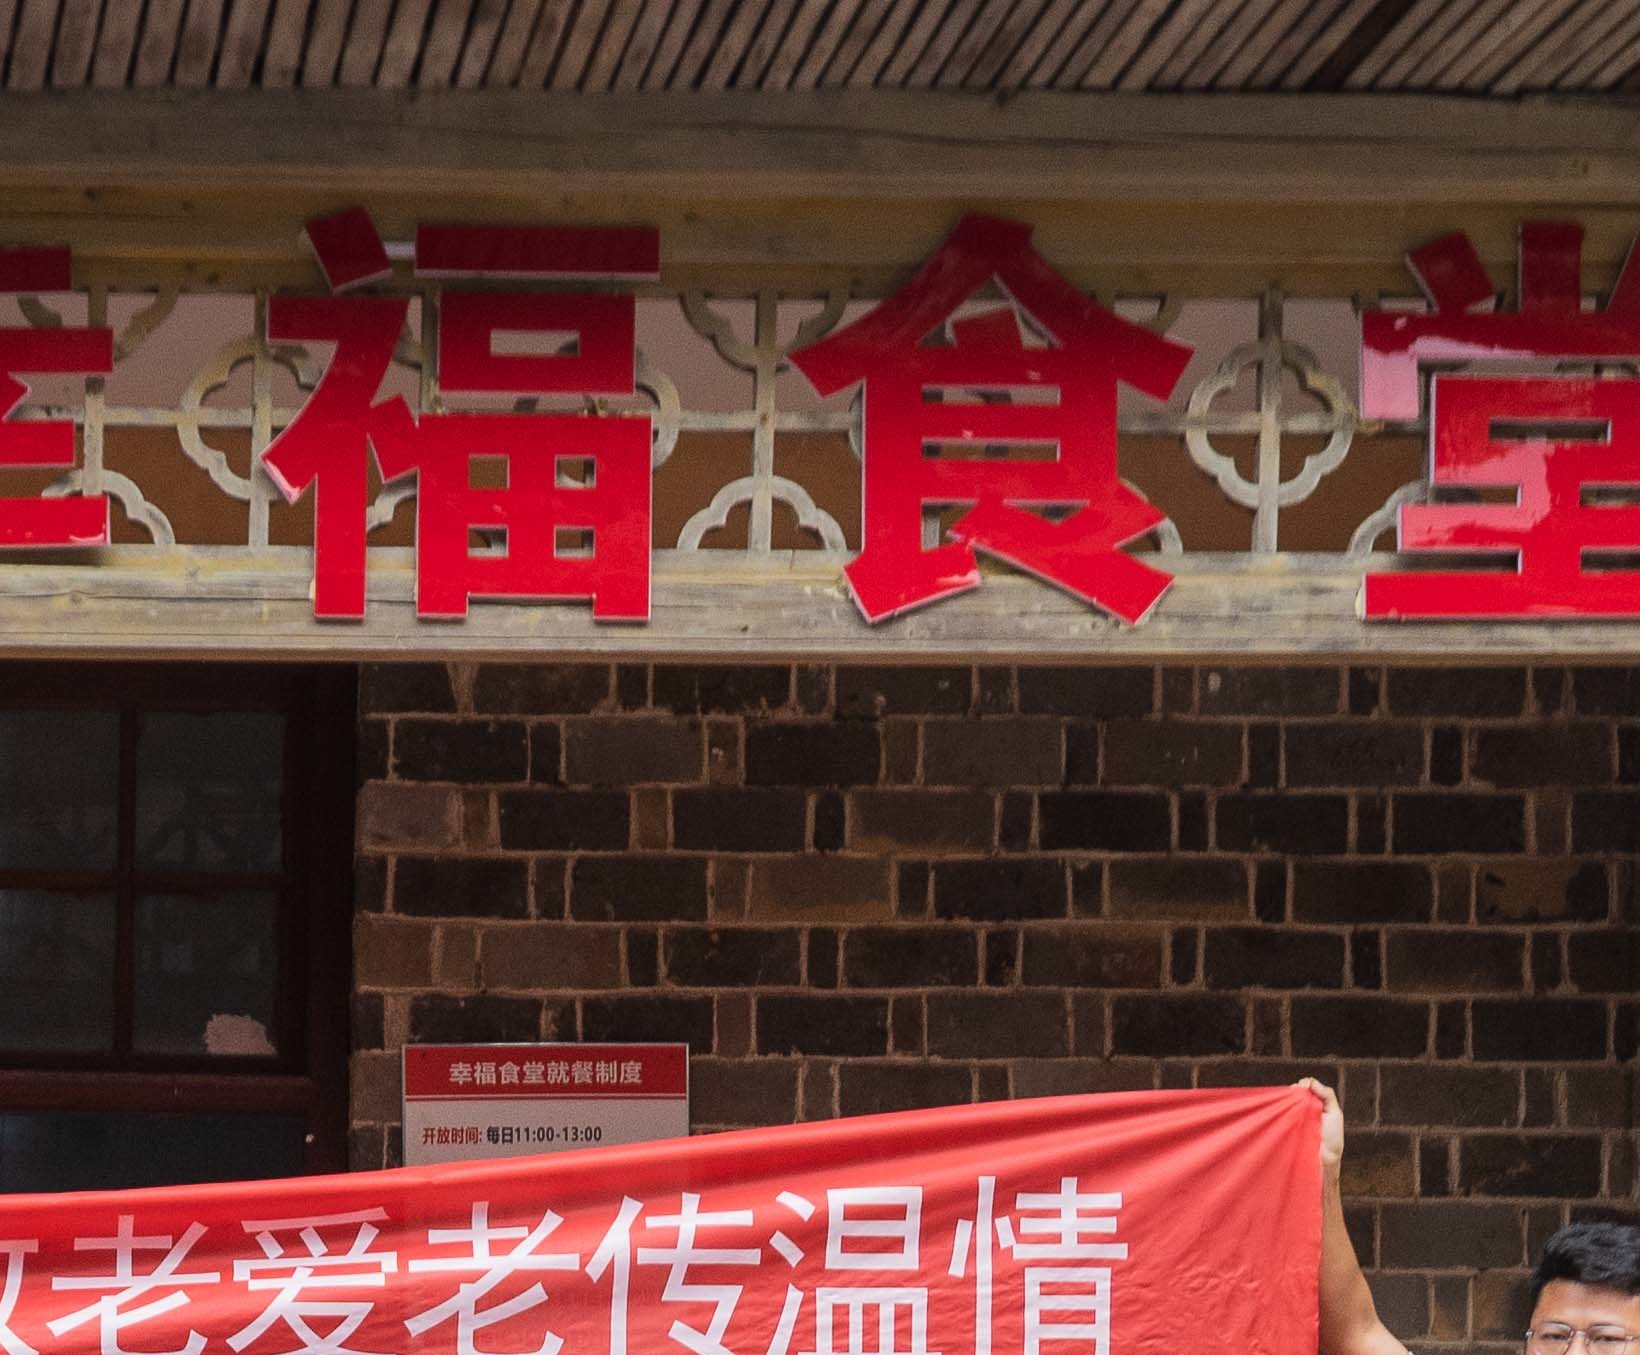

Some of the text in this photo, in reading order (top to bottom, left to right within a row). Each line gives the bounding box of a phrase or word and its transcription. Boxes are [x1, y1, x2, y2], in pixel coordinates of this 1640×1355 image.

[448, 1061, 644, 1086] 幸福食堂就餐制度
[422, 1126, 603, 1146] 开放时间: 每日11:00-13:00
